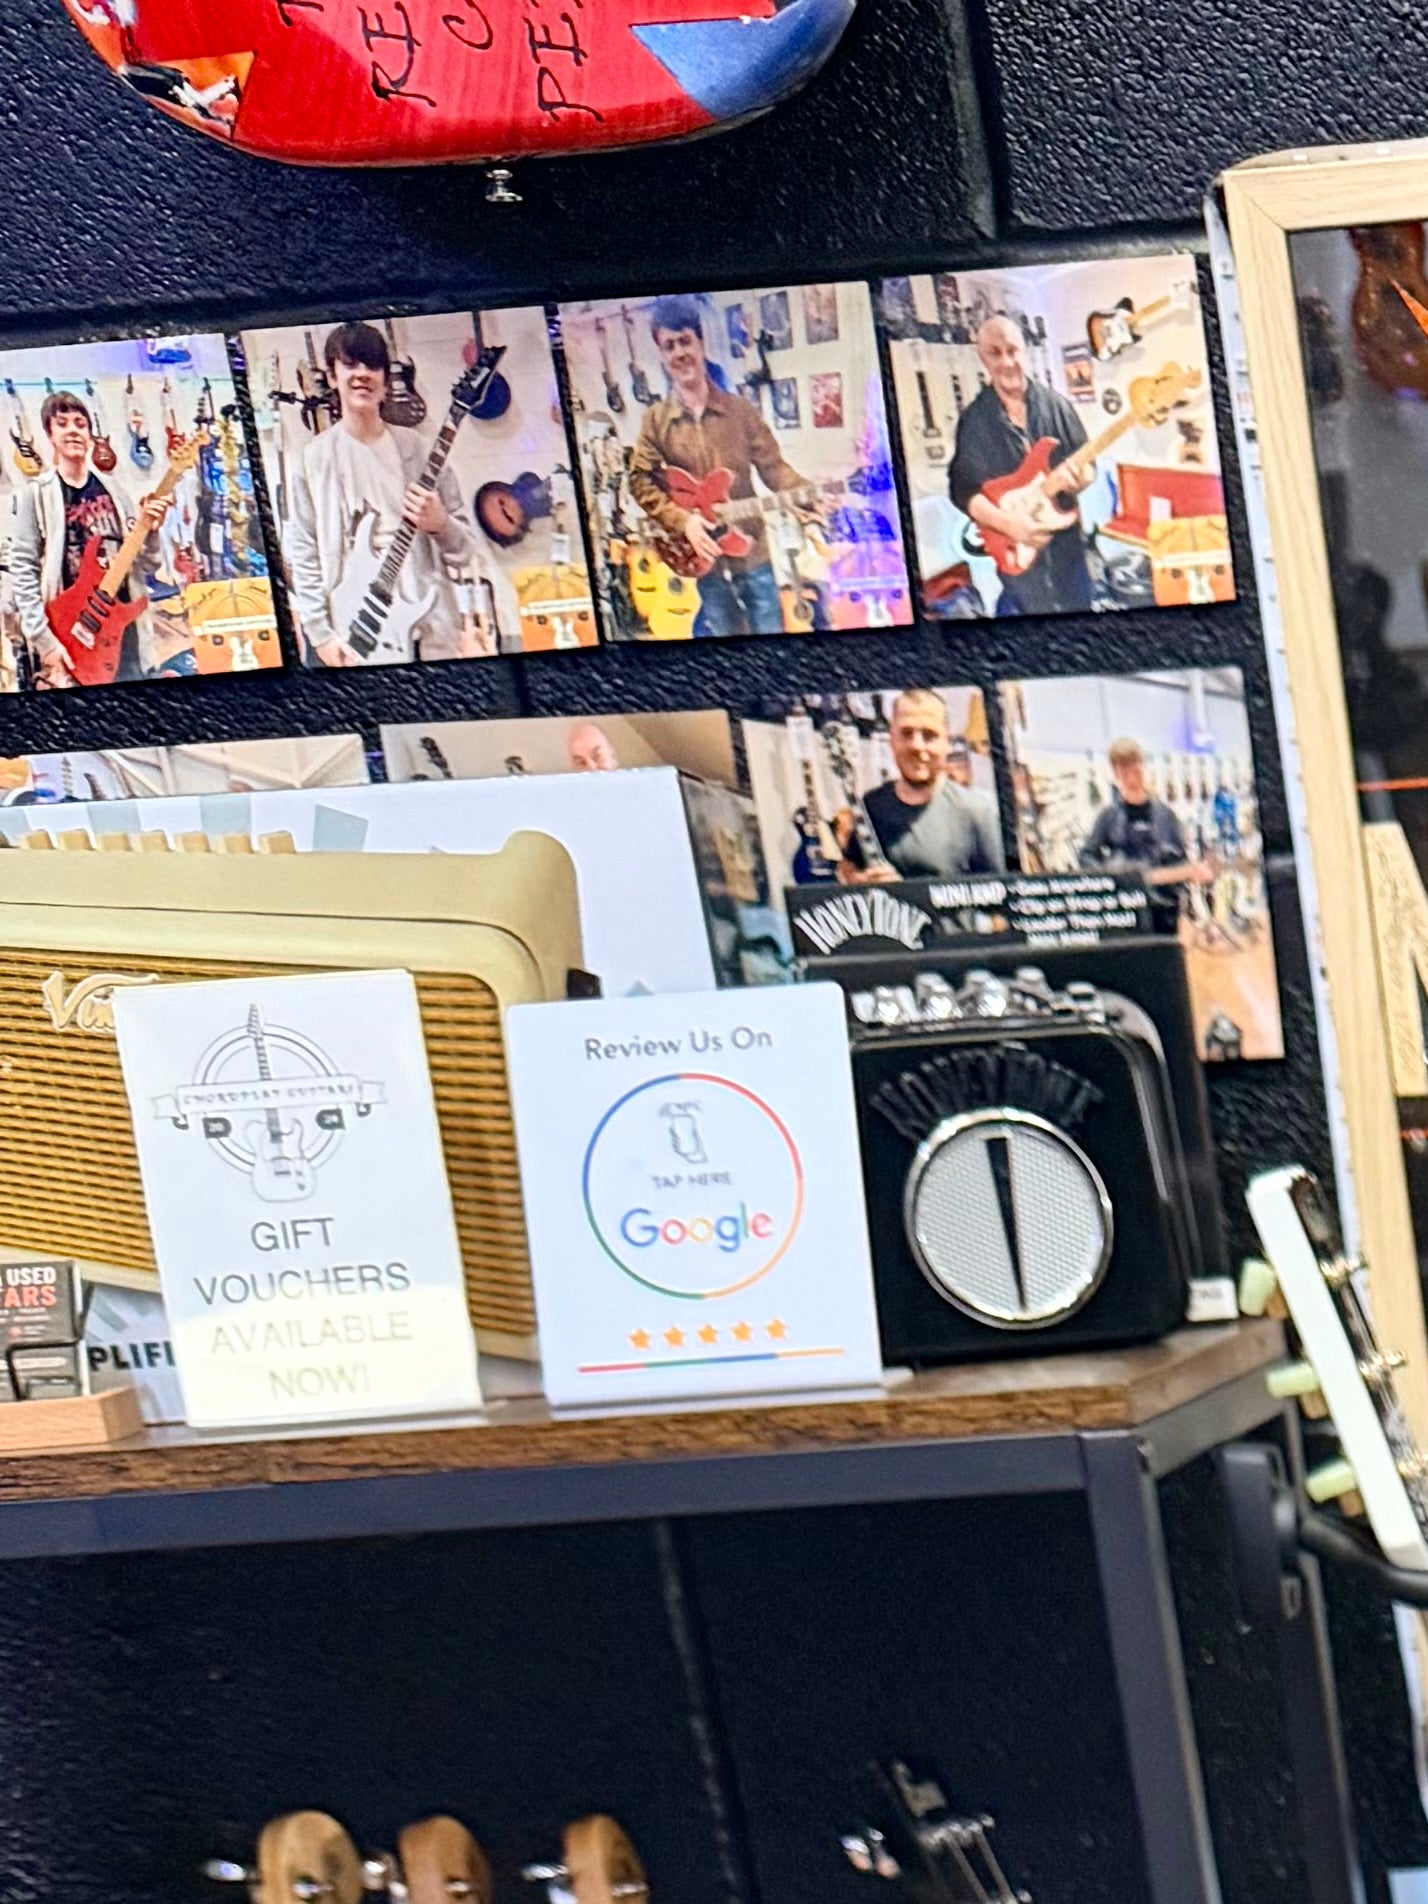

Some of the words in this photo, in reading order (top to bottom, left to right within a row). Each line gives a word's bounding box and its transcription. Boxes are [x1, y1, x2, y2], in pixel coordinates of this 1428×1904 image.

[584, 1035, 682, 1060] Review
[689, 1029, 724, 1053] Us
[730, 1026, 773, 1050] On
[250, 1216, 335, 1252] GIFT
[620, 1201, 774, 1253] Google
[6, 1267, 57, 1286] USED
[192, 1262, 411, 1305] VOUCHERS
[2, 1286, 57, 1308] ARS
[210, 1311, 412, 1355] AVAILABLE
